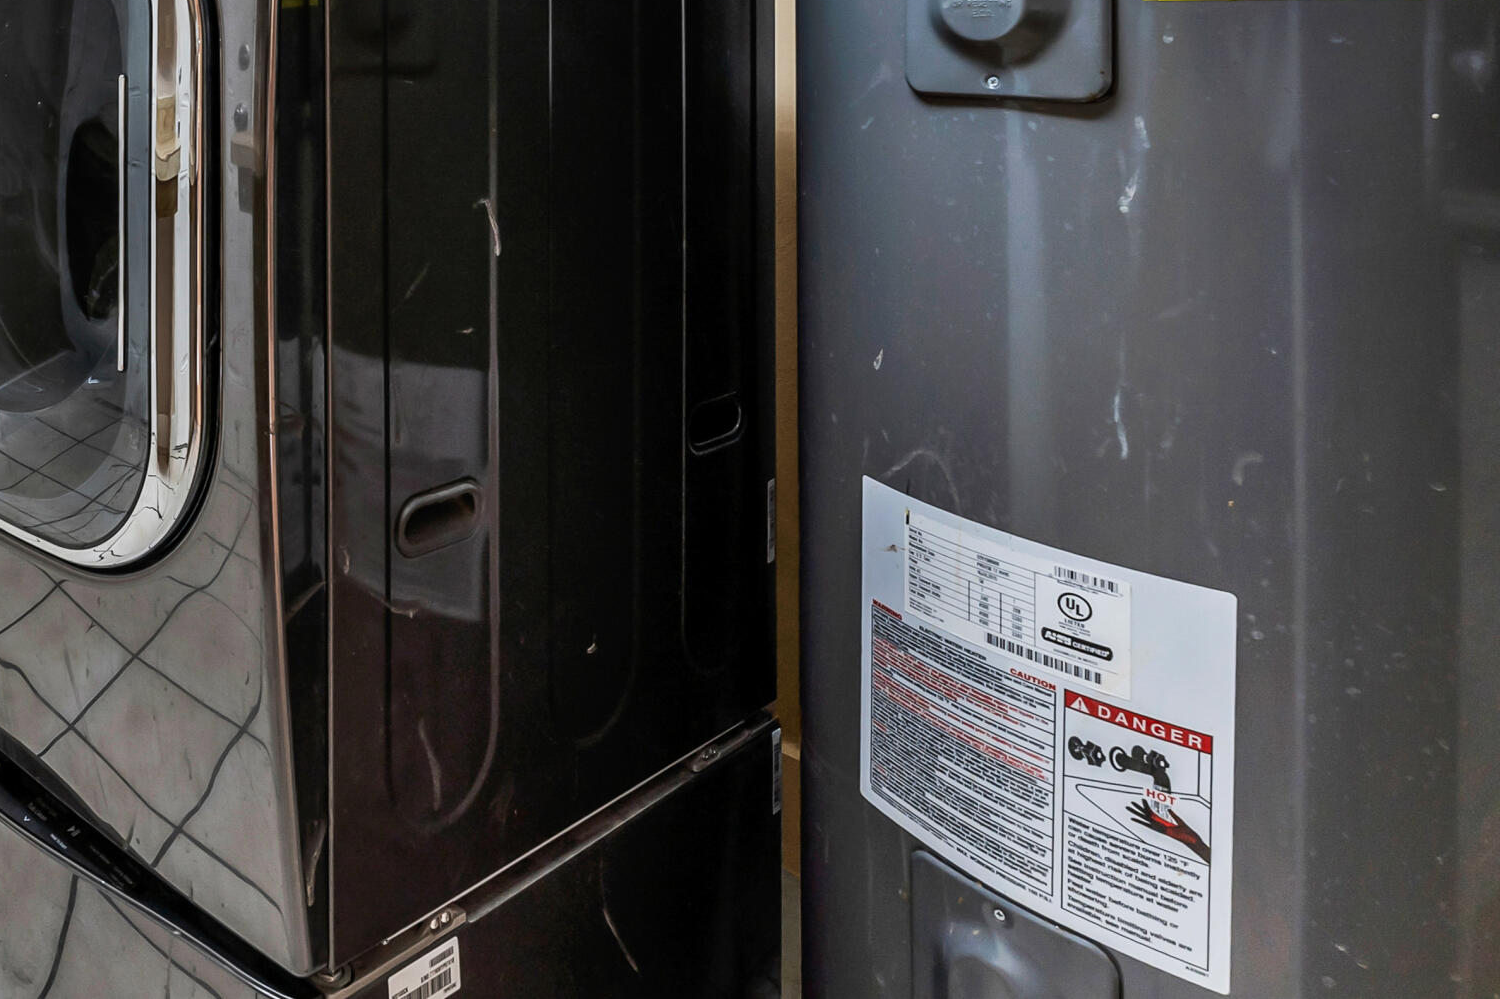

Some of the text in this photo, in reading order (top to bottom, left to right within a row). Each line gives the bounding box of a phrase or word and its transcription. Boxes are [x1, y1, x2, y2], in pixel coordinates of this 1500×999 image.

[1010, 668, 1056, 690] CAUTION
[1098, 705, 1202, 750] DANGER
[1146, 788, 1177, 806] HOT
[1068, 817, 1090, 830] Water
[1092, 827, 1140, 850] temperature
[1142, 847, 1160, 858] over
[1164, 854, 1178, 864] 125
[1068, 824, 1200, 880] can cause severe burns instantly
[1078, 835, 1099, 848] death
[1101, 844, 1120, 856] from
[1068, 840, 1203, 898] Children, disabled and elderly are
[1068, 856, 1188, 909] See instruction manual before
[1068, 863, 1094, 880] setting
[1096, 875, 1144, 900] temperature
[1156, 900, 1179, 913] water
[1077, 850, 1106, 867] highest
[1107, 863, 1123, 874] risk
[1135, 875, 1158, 890] being
[1160, 885, 1195, 903] scalded.
[1068, 878, 1083, 890] Feel
[1086, 888, 1107, 900] water
[1108, 896, 1135, 912] before
[1136, 908, 1168, 927] bathing
[1068, 894, 1192, 952] Temperature limiting valves are
[1105, 920, 1119, 929] see
